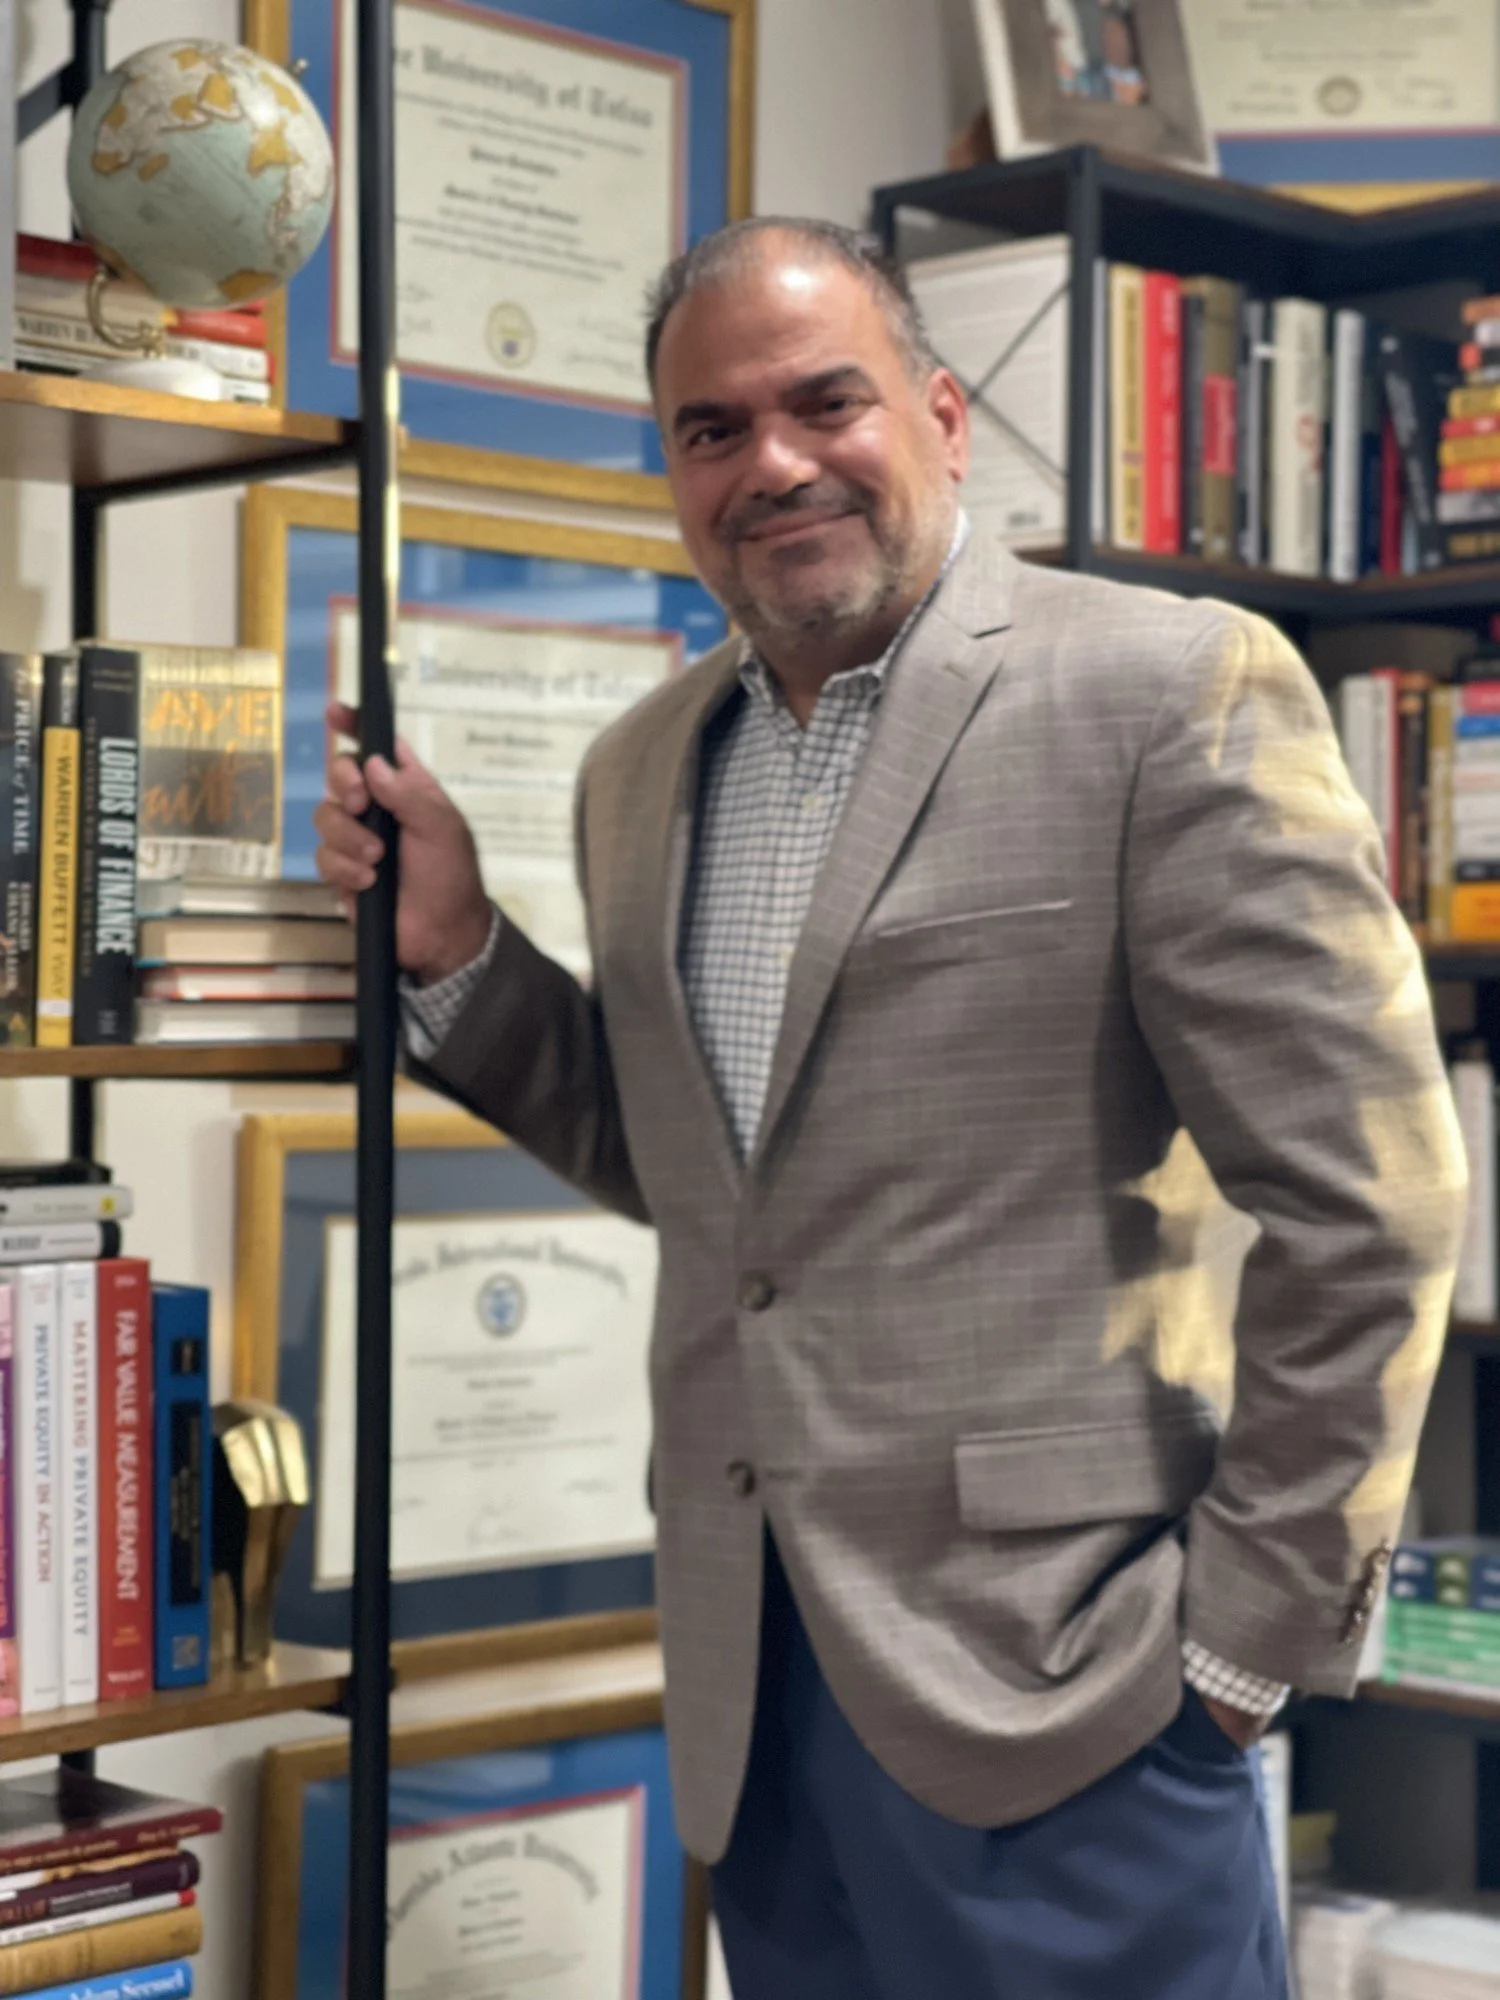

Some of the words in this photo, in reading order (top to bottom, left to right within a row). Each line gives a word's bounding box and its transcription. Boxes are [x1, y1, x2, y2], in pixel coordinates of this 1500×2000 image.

[14, 700, 31, 768] PRICE
[55, 755, 73, 846] WARREN
[99, 736, 138, 815] LORDS
[13, 794, 30, 855] TIME
[98, 818, 136, 849] OF
[52, 853, 70, 945] BUFFETT
[96, 857, 136, 955] FINANCE
[51, 954, 67, 998] WAY
[35, 1324, 49, 1400] PRIVATE
[115, 1310, 139, 1357] FAIR
[73, 1321, 88, 1449] MASTERING
[115, 1360, 139, 1427] VALUE
[35, 1406, 50, 1477] EQUITY
[36, 1483, 51, 1505] IN
[73, 1455, 88, 1544] PRIVATE
[115, 1432, 140, 1601] MEASUREMENT
[37, 1512, 52, 1583] ACTION
[73, 1556, 88, 1636] EQUITY
